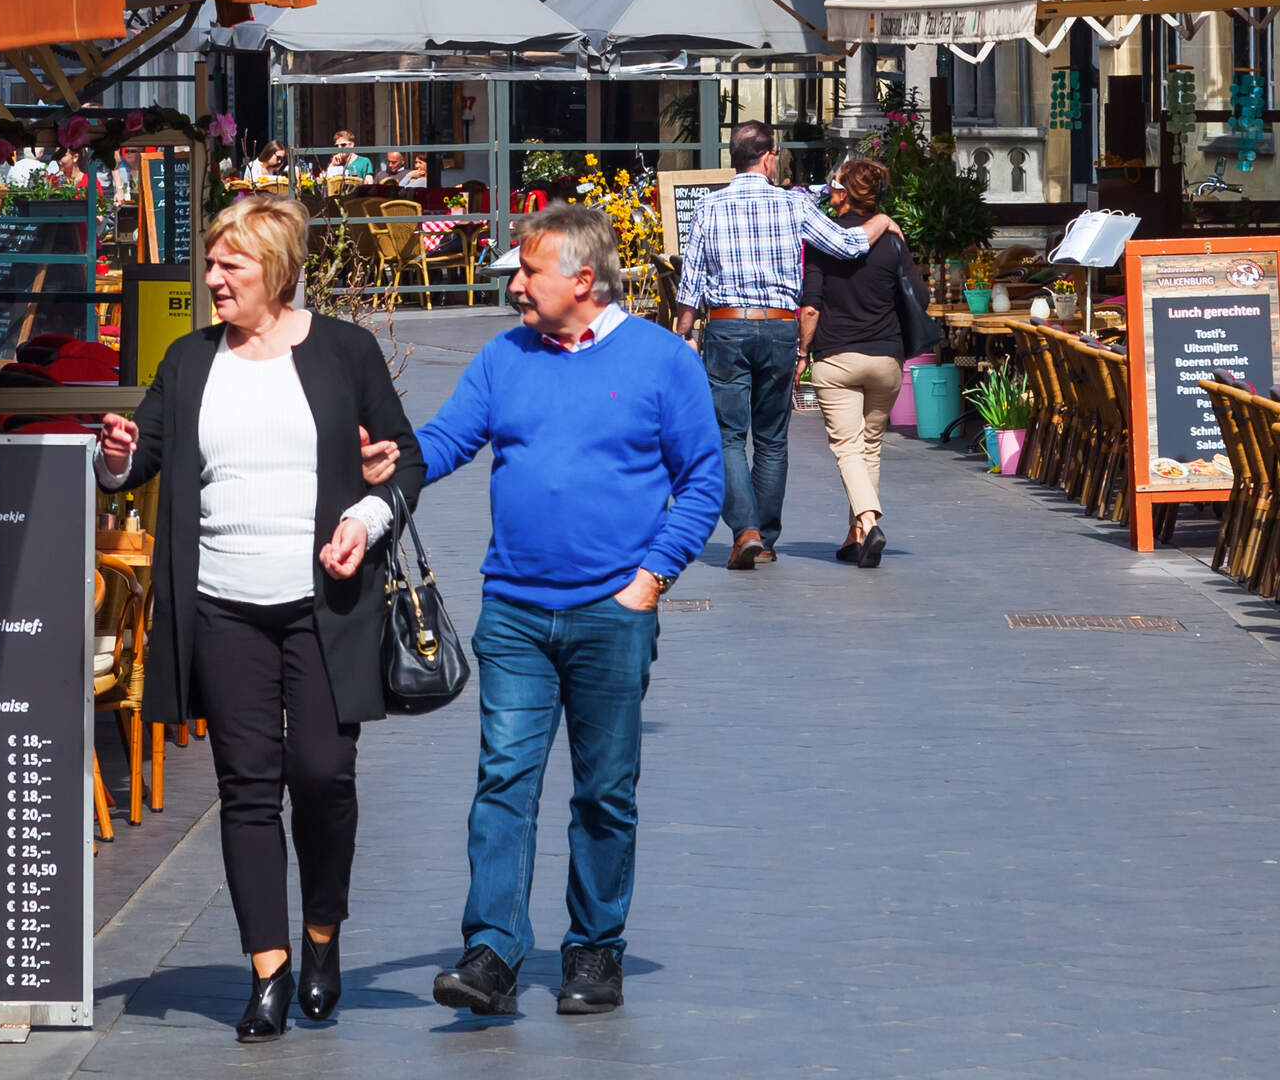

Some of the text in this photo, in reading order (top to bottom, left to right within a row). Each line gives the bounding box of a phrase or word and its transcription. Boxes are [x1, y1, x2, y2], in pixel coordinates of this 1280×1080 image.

[1157, 276, 1215, 287] VALKENBURG
[1168, 305, 1261, 320] Lunch gerechten
[1195, 329, 1227, 339] Tosti's
[1184, 342, 1239, 354] Uitsmijters
[1175, 355, 1249, 368] Boeren omelet
[1190, 426, 1221, 437] Schnit
[7, 735, 17, 746] €
[7, 754, 17, 765] €
[7, 772, 17, 783] €
[7, 790, 17, 801] €
[7, 809, 17, 820] €
[7, 827, 17, 838] €
[7, 845, 17, 856] €
[6, 864, 16, 875] €
[6, 882, 16, 893] €
[6, 900, 16, 911] €
[6, 919, 16, 930] €
[6, 937, 16, 948] €
[6, 955, 16, 966] €
[6, 974, 16, 985] €
